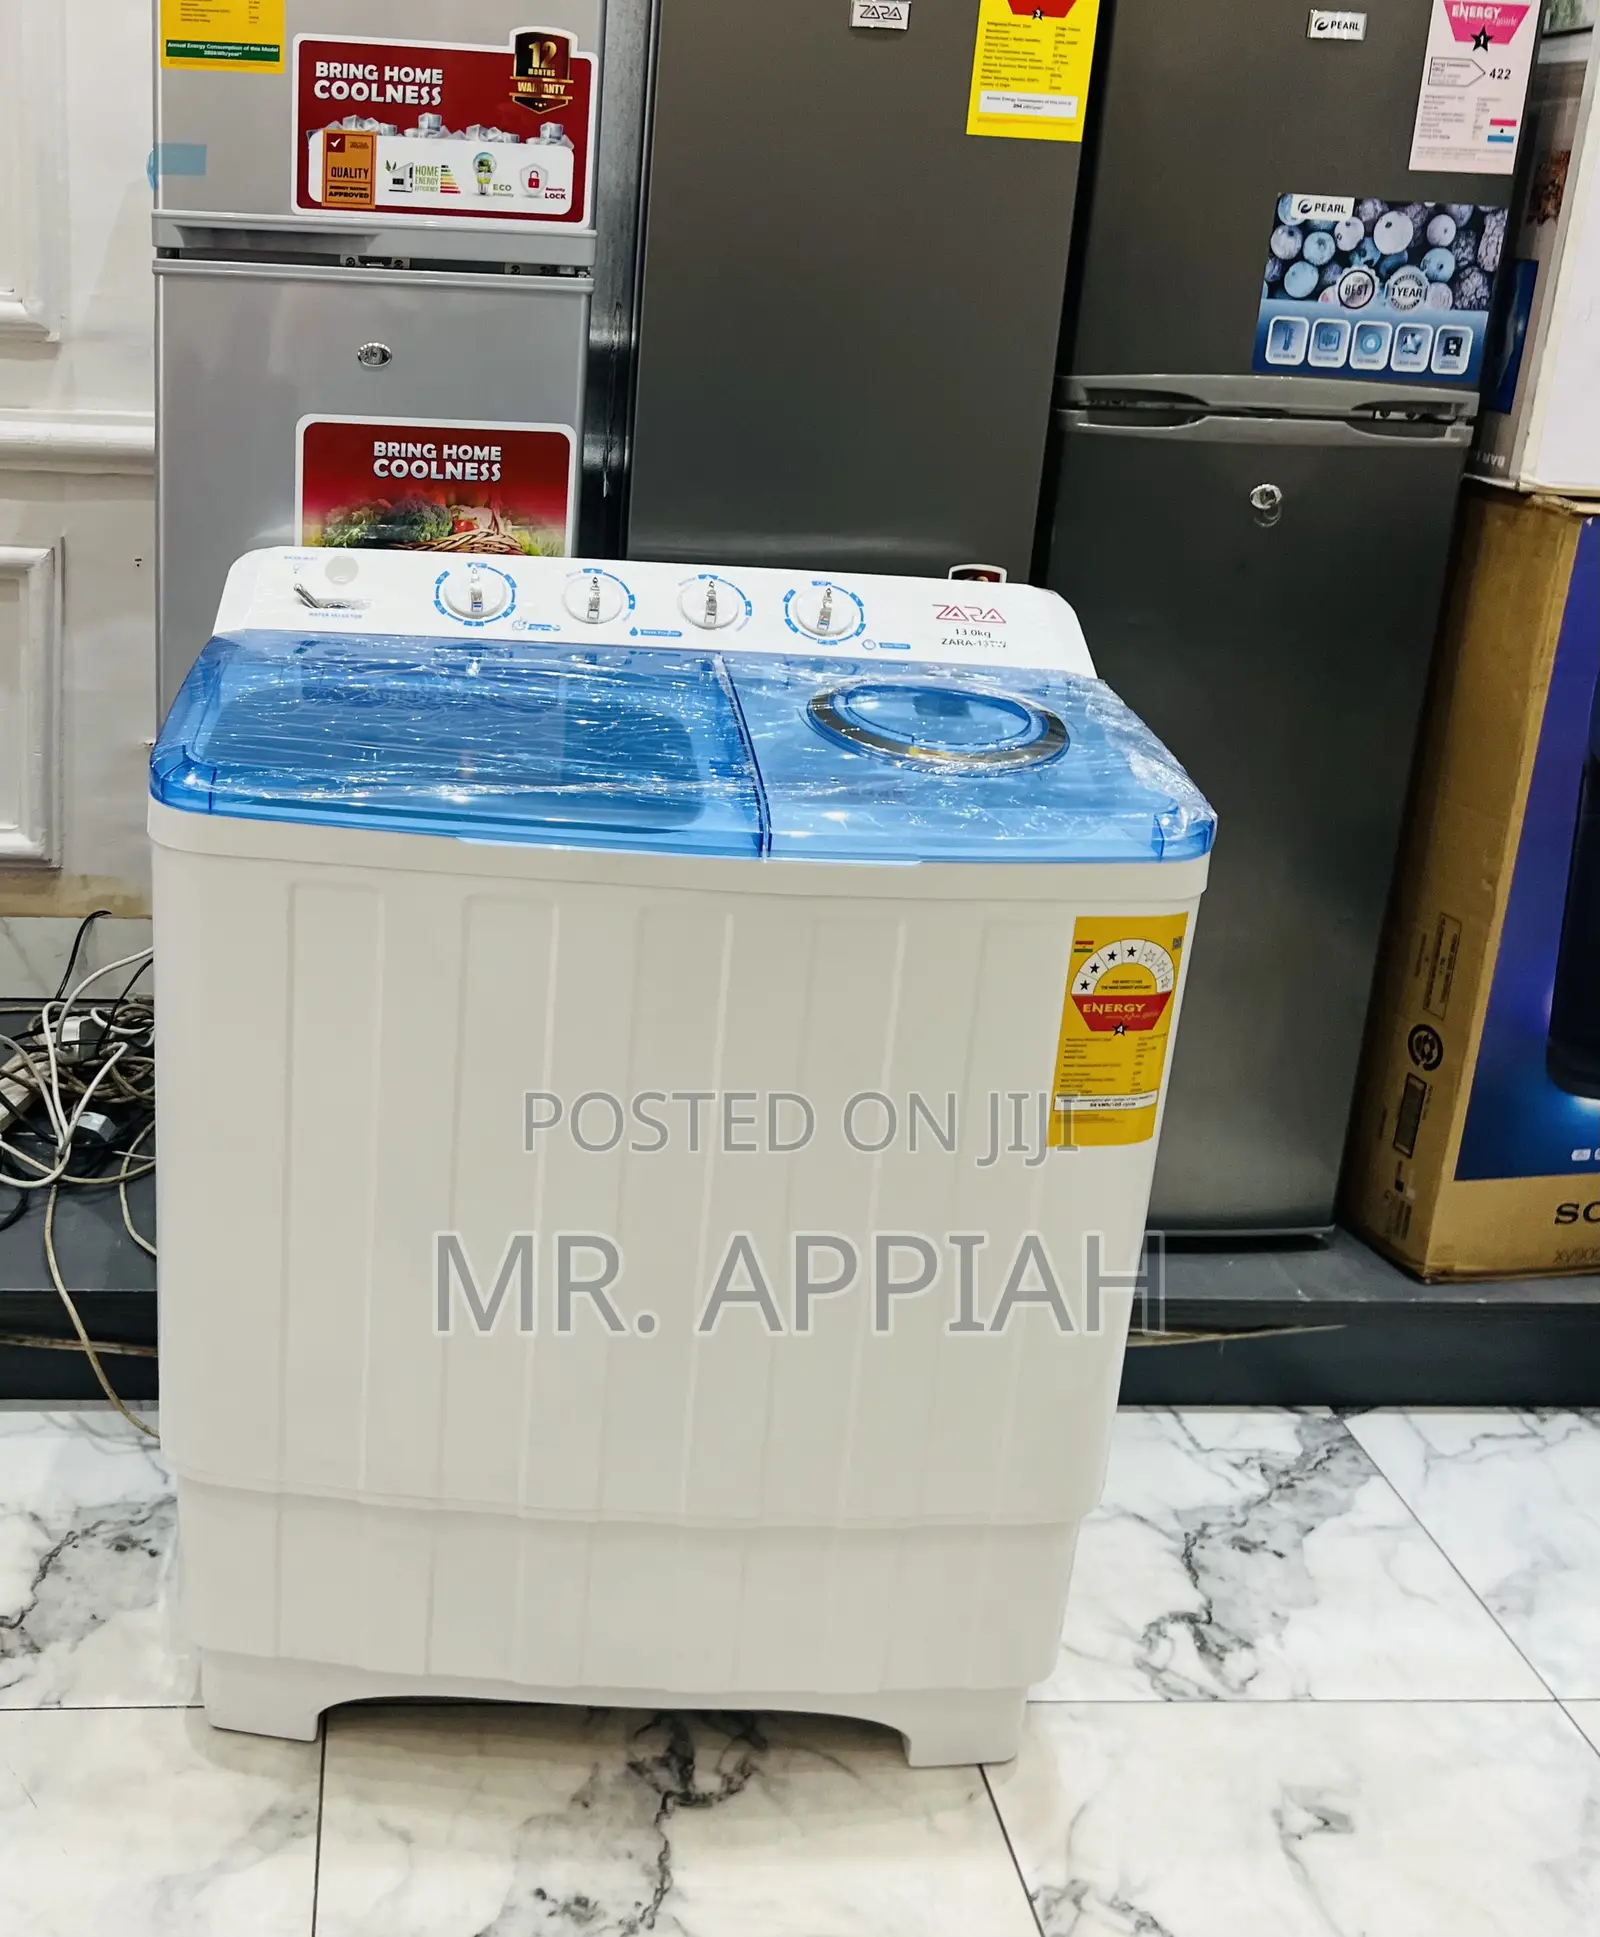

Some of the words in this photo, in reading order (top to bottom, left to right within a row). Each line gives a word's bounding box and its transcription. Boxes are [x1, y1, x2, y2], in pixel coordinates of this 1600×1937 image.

[859, 4, 902, 20] ZARA
[1451, 3, 1502, 21] ENERGY
[1330, 19, 1360, 31] PEARL
[528, 41, 557, 68] 12
[315, 61, 379, 81] BRING
[384, 65, 444, 84] HOME
[528, 68, 556, 77] MONTHS
[1489, 69, 1512, 80] 422
[313, 80, 442, 106] COOLNESS
[518, 81, 566, 95] WAANTY
[331, 166, 369, 180] QUALITY
[414, 165, 440, 177] HOME
[414, 176, 439, 185] ENERGY
[493, 183, 512, 192] ECO
[328, 191, 369, 199] APPROVED
[1314, 202, 1346, 214] PEARL
[1344, 283, 1369, 296] BEST
[373, 441, 437, 459] BRING
[443, 444, 502, 462] HOME
[373, 458, 502, 482] COOLNESS
[932, 603, 1007, 624] ZARA
[1082, 1002, 1146, 1015] ENERGY
